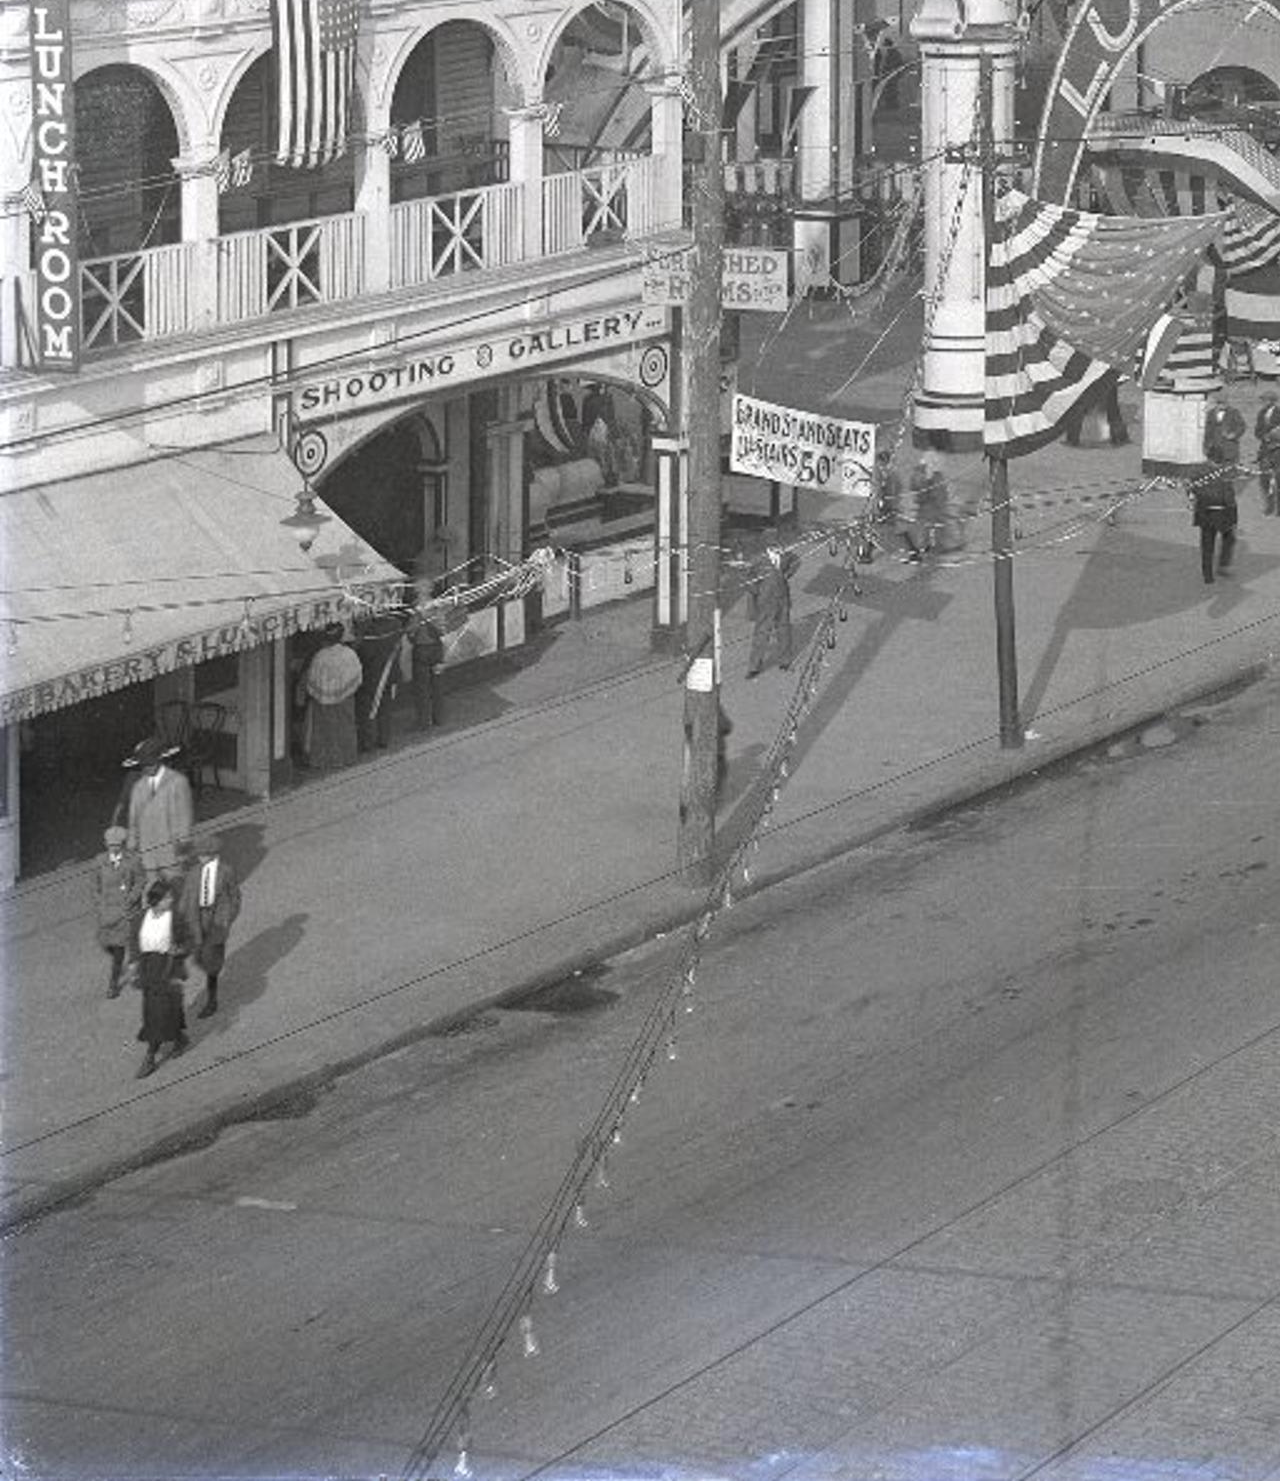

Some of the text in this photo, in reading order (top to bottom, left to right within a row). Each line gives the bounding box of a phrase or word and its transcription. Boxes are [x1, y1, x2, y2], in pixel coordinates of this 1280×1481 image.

[34, 8, 68, 192] LUNCH
[39, 211, 73, 358] ROOM
[301, 311, 643, 410] SHOOTING GALLERY
[827, 422, 871, 455] SEATS
[39, 649, 171, 707] BAKERY
